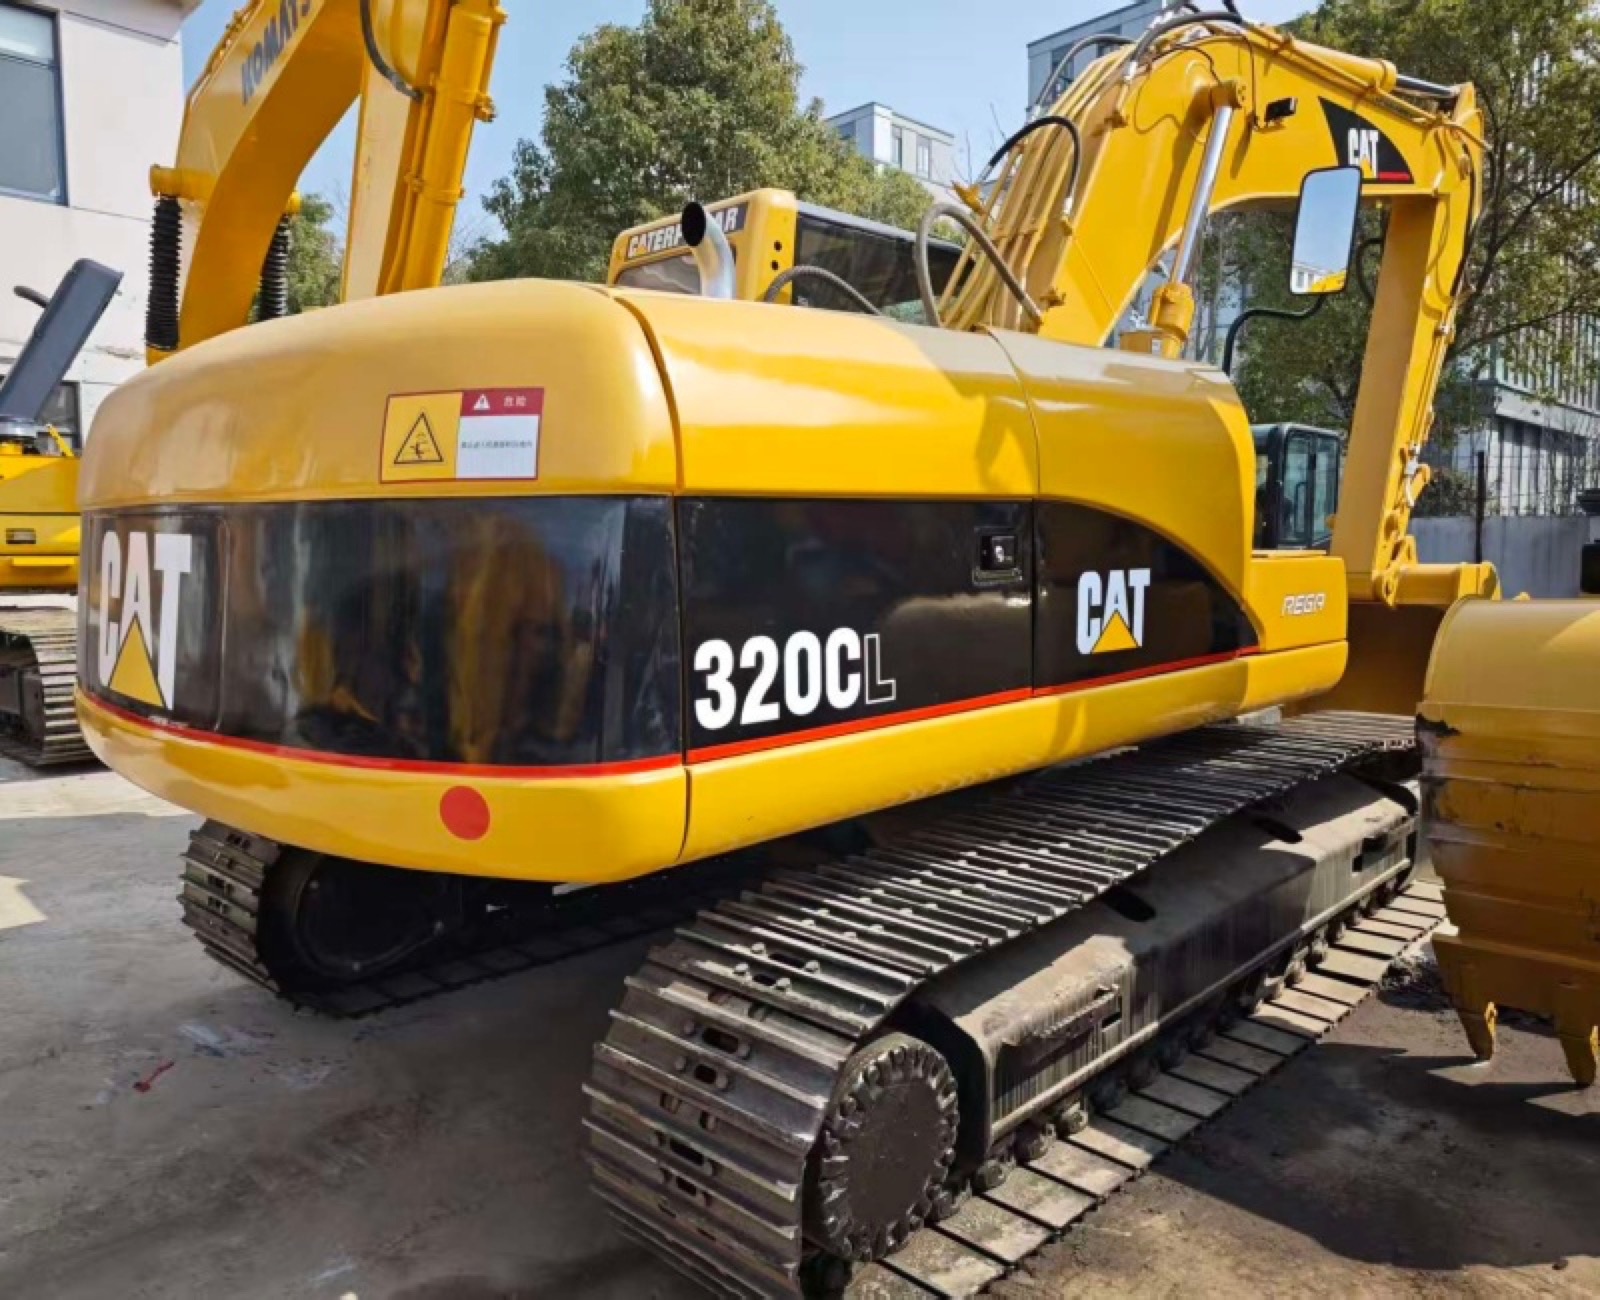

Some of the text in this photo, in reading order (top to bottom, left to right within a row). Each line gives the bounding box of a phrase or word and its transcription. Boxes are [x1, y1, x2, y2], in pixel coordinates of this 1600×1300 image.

[1347, 128, 1378, 178] CAT
[627, 206, 738, 258] CATERPAR
[99, 531, 191, 710] CAT
[1077, 568, 1151, 654] CAT
